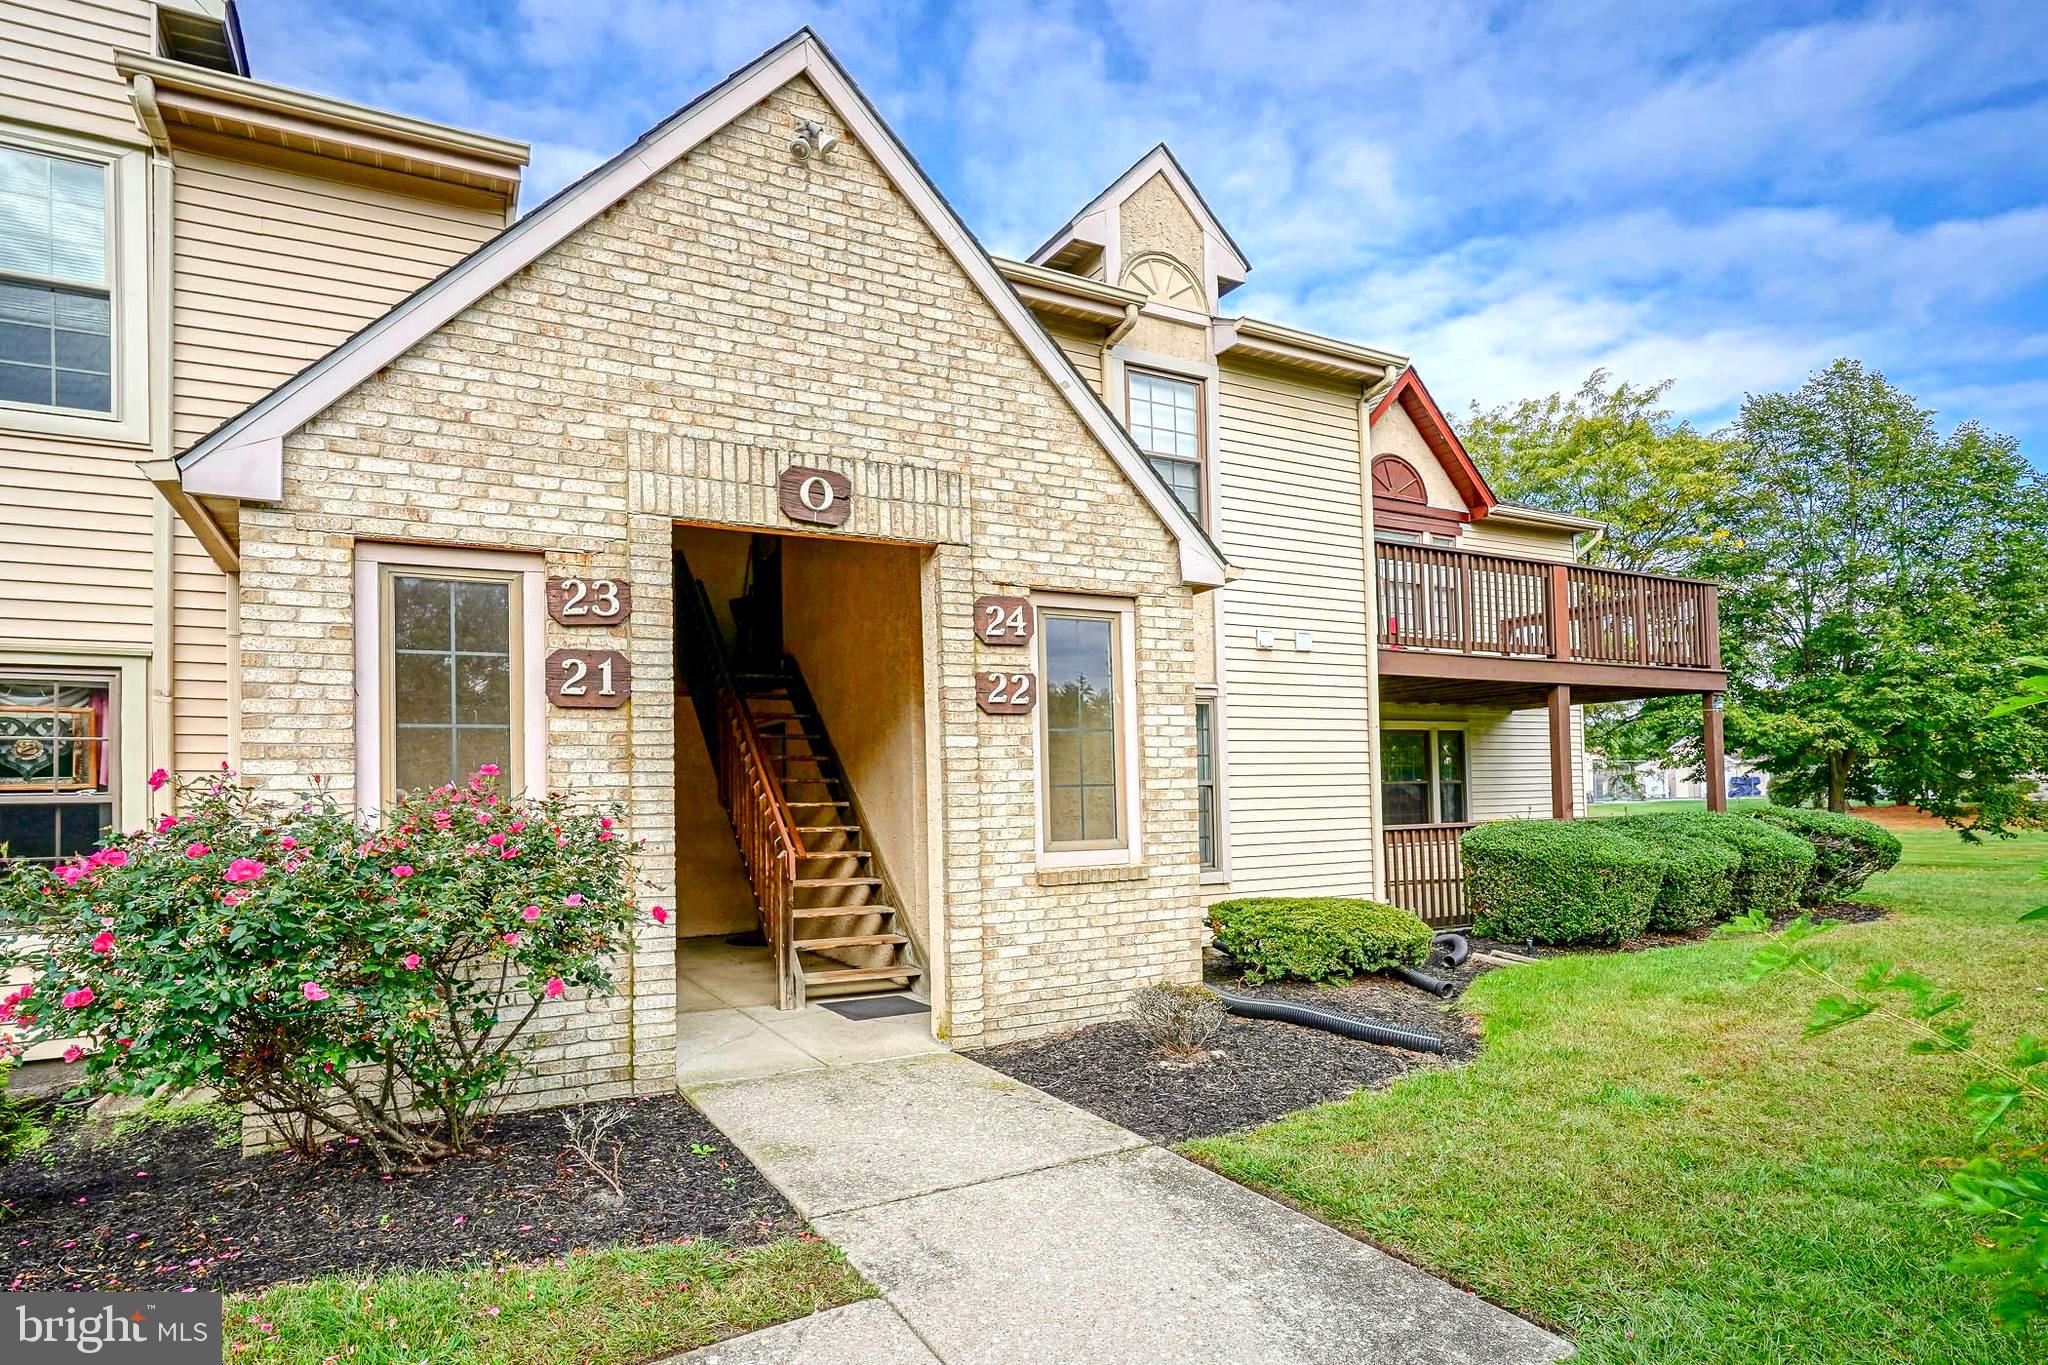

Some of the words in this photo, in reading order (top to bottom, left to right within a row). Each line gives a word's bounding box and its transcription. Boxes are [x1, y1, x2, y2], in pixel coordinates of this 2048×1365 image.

[800, 476, 834, 511] O
[561, 579, 620, 617] 23
[985, 605, 1028, 637] 24
[560, 657, 616, 696] 21
[987, 672, 1030, 706] 22
